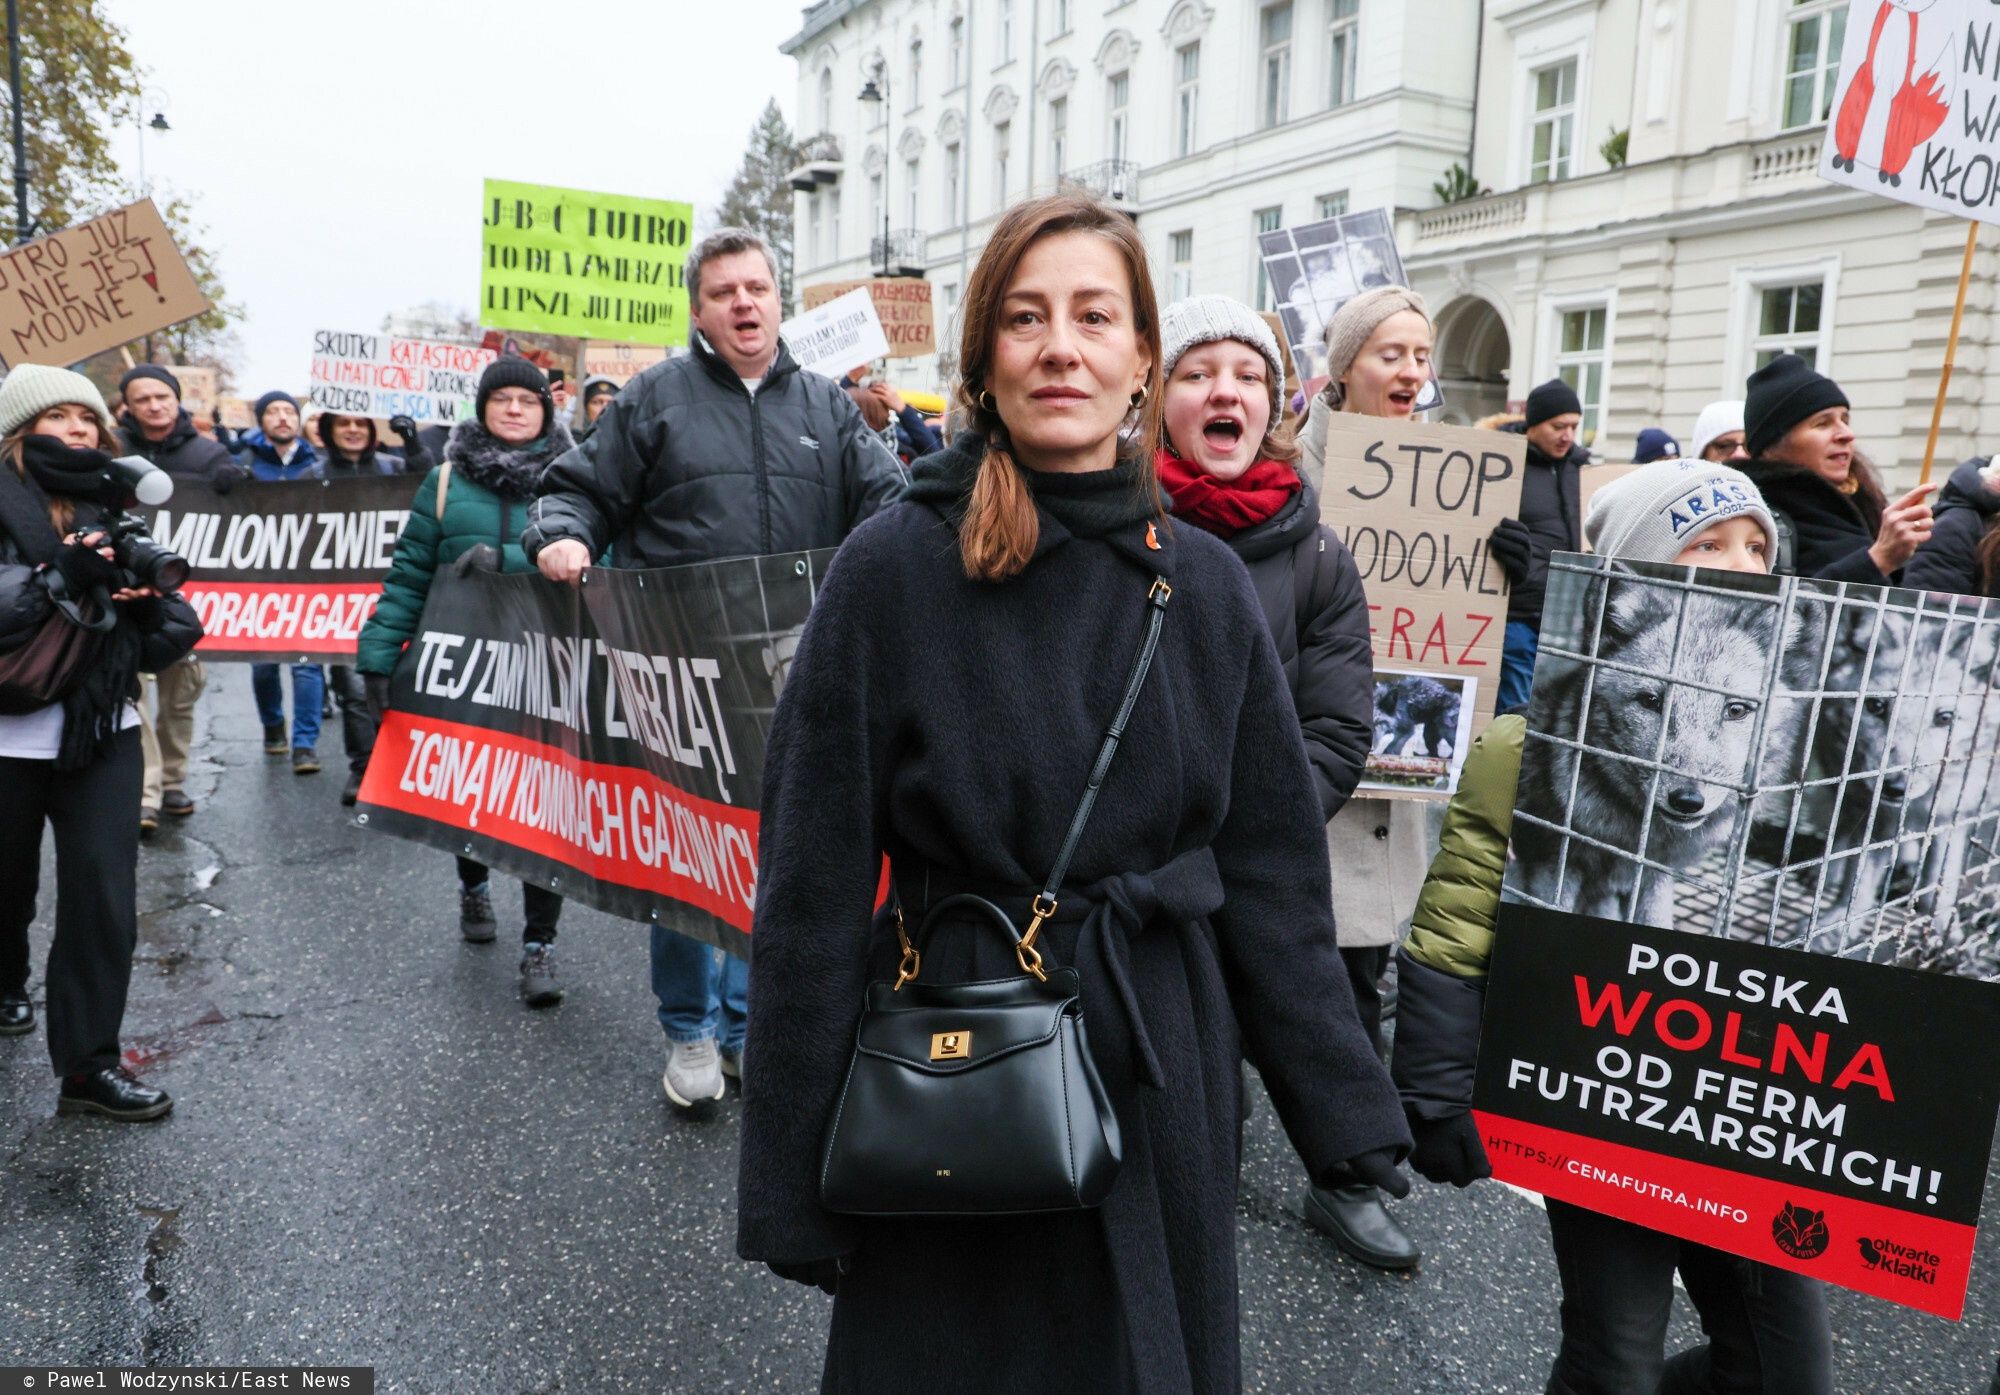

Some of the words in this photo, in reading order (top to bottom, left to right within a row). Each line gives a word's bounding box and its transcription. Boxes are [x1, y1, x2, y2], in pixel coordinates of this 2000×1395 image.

[18, 270, 80, 316] NIE
[80, 237, 152, 293] JEST
[488, 244, 518, 269] TO
[311, 358, 426, 392] KLIMATYCZNEJ
[315, 330, 378, 359] SKUTKI
[438, 400, 456, 422] NA
[1347, 440, 1513, 517] STOP
[1670, 485, 1757, 533] ARAS
[151, 510, 312, 570] MILIONY
[1345, 526, 1509, 597] ODOWL
[414, 631, 483, 700] TEJ
[471, 639, 527, 711] ZIMY
[595, 638, 737, 805] ZWIERZĄT
[400, 728, 491, 828] ZGINĄ
[487, 746, 520, 817] W
[509, 753, 628, 861] KOMORACH
[1627, 943, 1850, 1025] POLSKA
[1573, 974, 1896, 1102] WOLNA
[1596, 1045, 1673, 1089] OD
[1693, 1068, 1847, 1137] FERM
[1507, 1058, 1943, 1205] FUTRZARSKICH!
[1488, 1135, 1749, 1224] HTTPS://CENAFUTRA.INFO
[1874, 1238, 1940, 1267] otwarte
[1879, 1255, 1937, 1285] klatki
